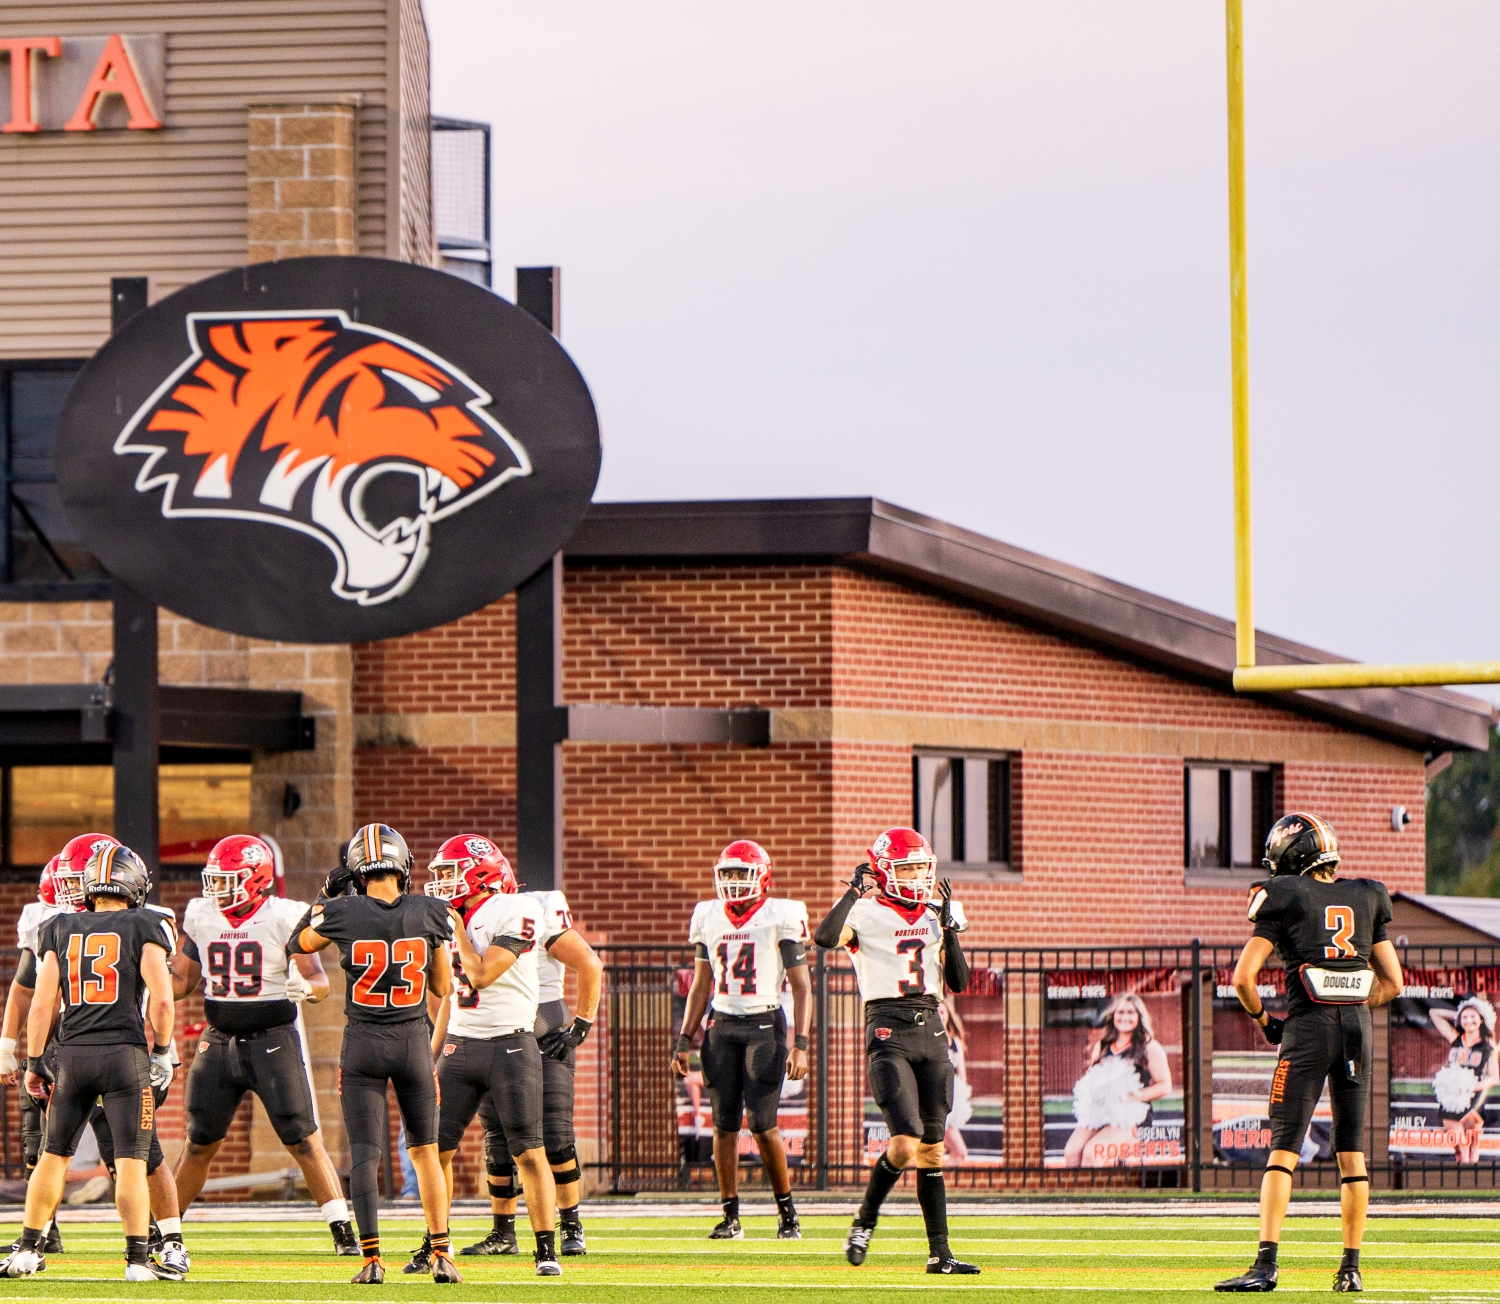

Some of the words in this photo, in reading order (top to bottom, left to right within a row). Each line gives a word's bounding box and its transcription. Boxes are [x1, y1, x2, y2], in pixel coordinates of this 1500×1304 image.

[359, 860, 394, 873] Riddell
[88, 884, 120, 893] Riddell
[219, 931, 249, 940] NORTHSIDE
[521, 916, 536, 940] 5
[722, 932, 750, 941] NORTHSIDE
[894, 927, 929, 937] NORTHSIDE
[1324, 905, 1358, 959] 3
[65, 931, 121, 1006] 13
[207, 941, 263, 998] 99
[351, 936, 428, 1008] 23
[716, 942, 757, 996] 14
[896, 938, 927, 997] 3
[1322, 975, 1362, 990] DOUGLAS
[1047, 986, 1080, 1000] SENIOR
[1081, 984, 1107, 998] 2025
[1430, 985, 1454, 999] 2025
[1271, 1060, 1291, 1104] TIGERS
[140, 1085, 154, 1131] TIGERS
[1394, 1115, 1427, 1130] HAILEY
[867, 1127, 891, 1140] AUBR
[1136, 1126, 1180, 1140] BRENLYN
[1220, 1129, 1273, 1149] BERR
[1093, 1140, 1181, 1160] ROBERTS
